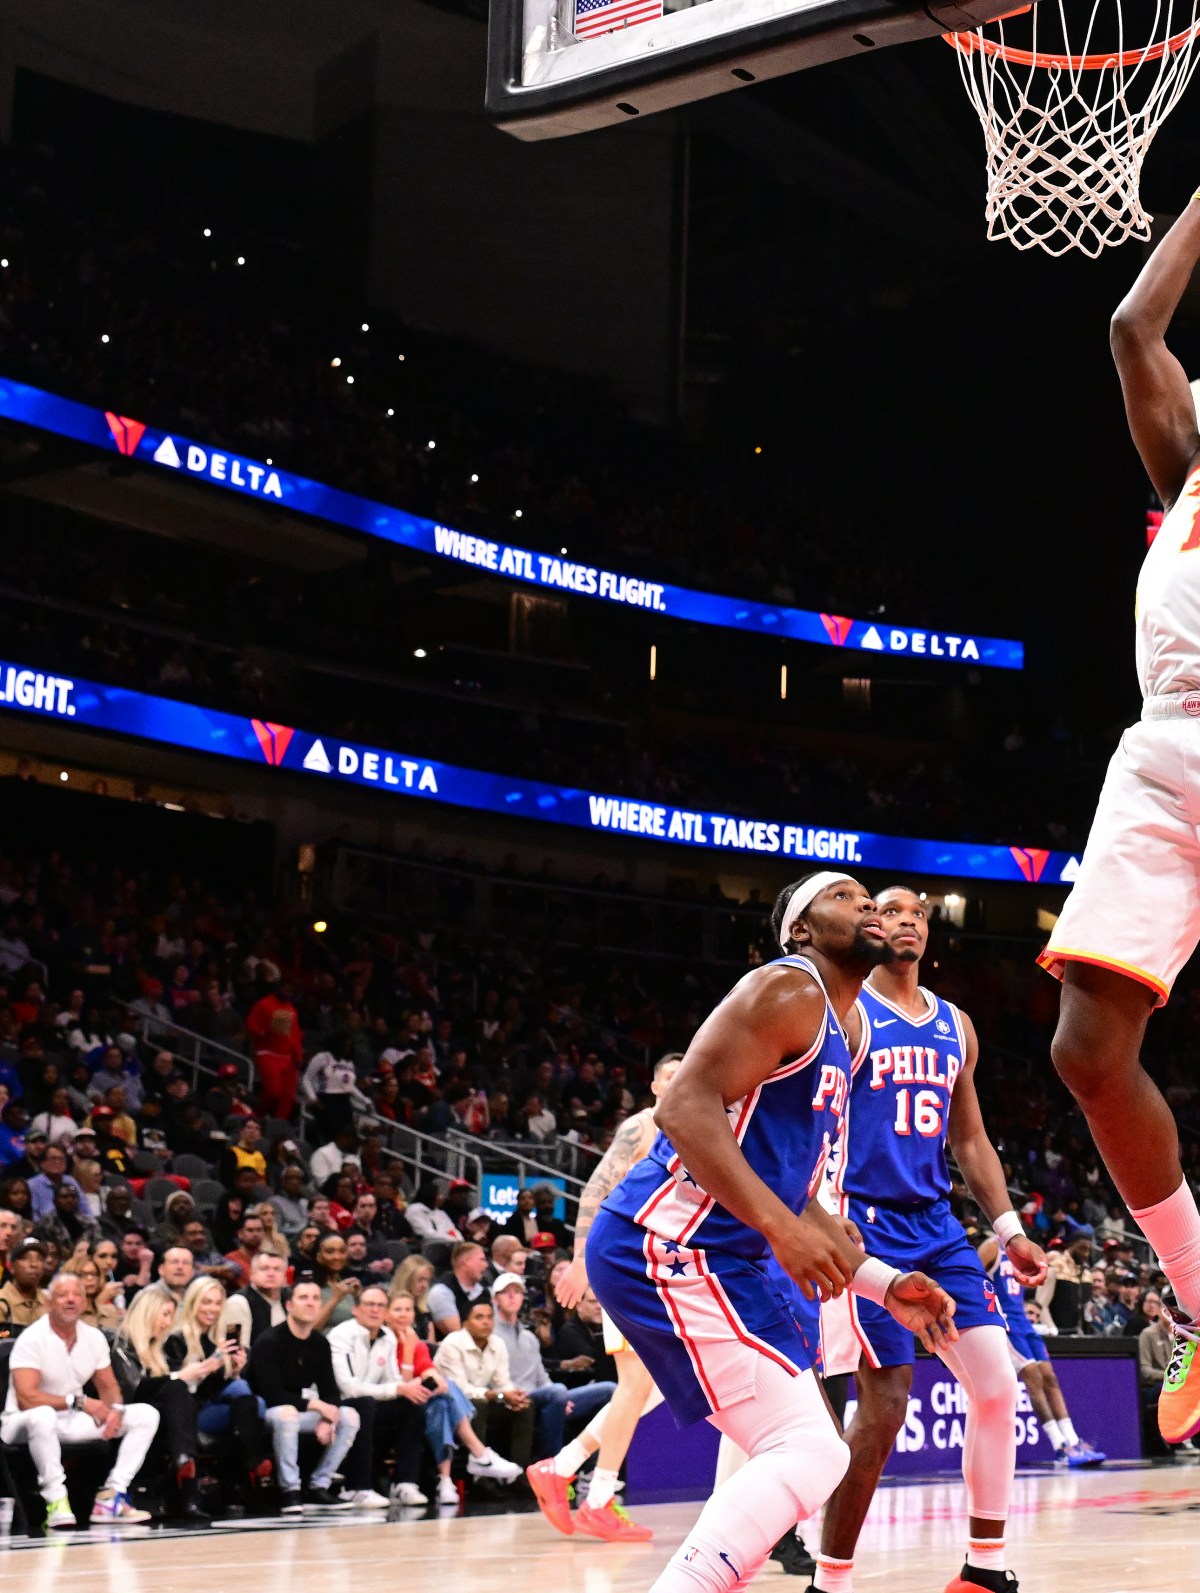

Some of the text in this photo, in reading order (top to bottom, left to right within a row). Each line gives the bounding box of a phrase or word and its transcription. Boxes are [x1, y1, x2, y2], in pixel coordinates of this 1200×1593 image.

[187, 445, 283, 498] DELTA
[434, 525, 667, 611] WHERE ATL TAKES FLIGHT.
[890, 630, 980, 660] DELTA
[337, 747, 439, 794] DELTA
[588, 795, 862, 863] WHERE ATL TAKES FLIGHT.
[895, 1089, 942, 1137] 16
